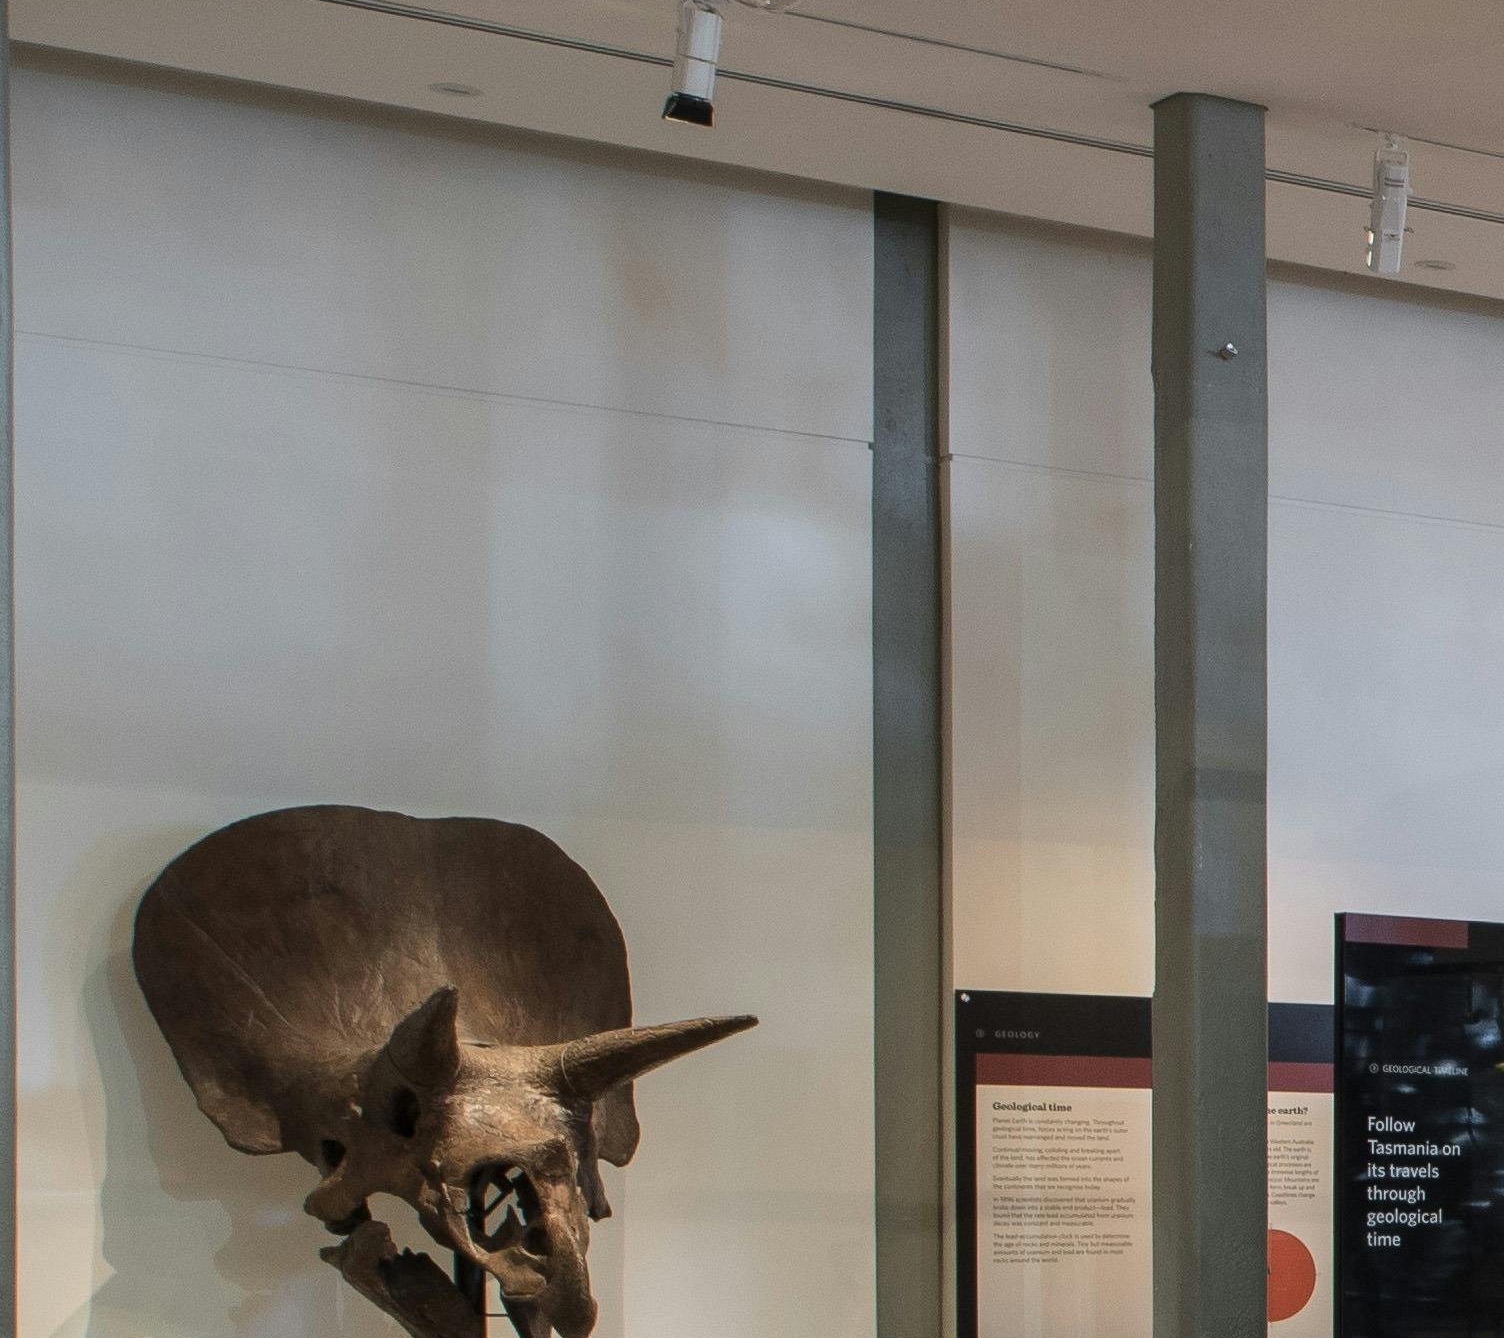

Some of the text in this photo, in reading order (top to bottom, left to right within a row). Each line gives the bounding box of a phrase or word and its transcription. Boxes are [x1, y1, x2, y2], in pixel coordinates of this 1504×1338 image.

[994, 1030, 1040, 1039] GEOLOGY
[1382, 1064, 1432, 1074] GEOLOGICAL
[993, 1102, 1072, 1112] Geological time
[1368, 1116, 1416, 1132] Follow
[1368, 1139, 1460, 1156] Tasmania on
[1367, 1163, 1439, 1178] its travels
[1367, 1185, 1426, 1203] through
[1367, 1208, 1442, 1227] geological
[1367, 1232, 1401, 1247] time
